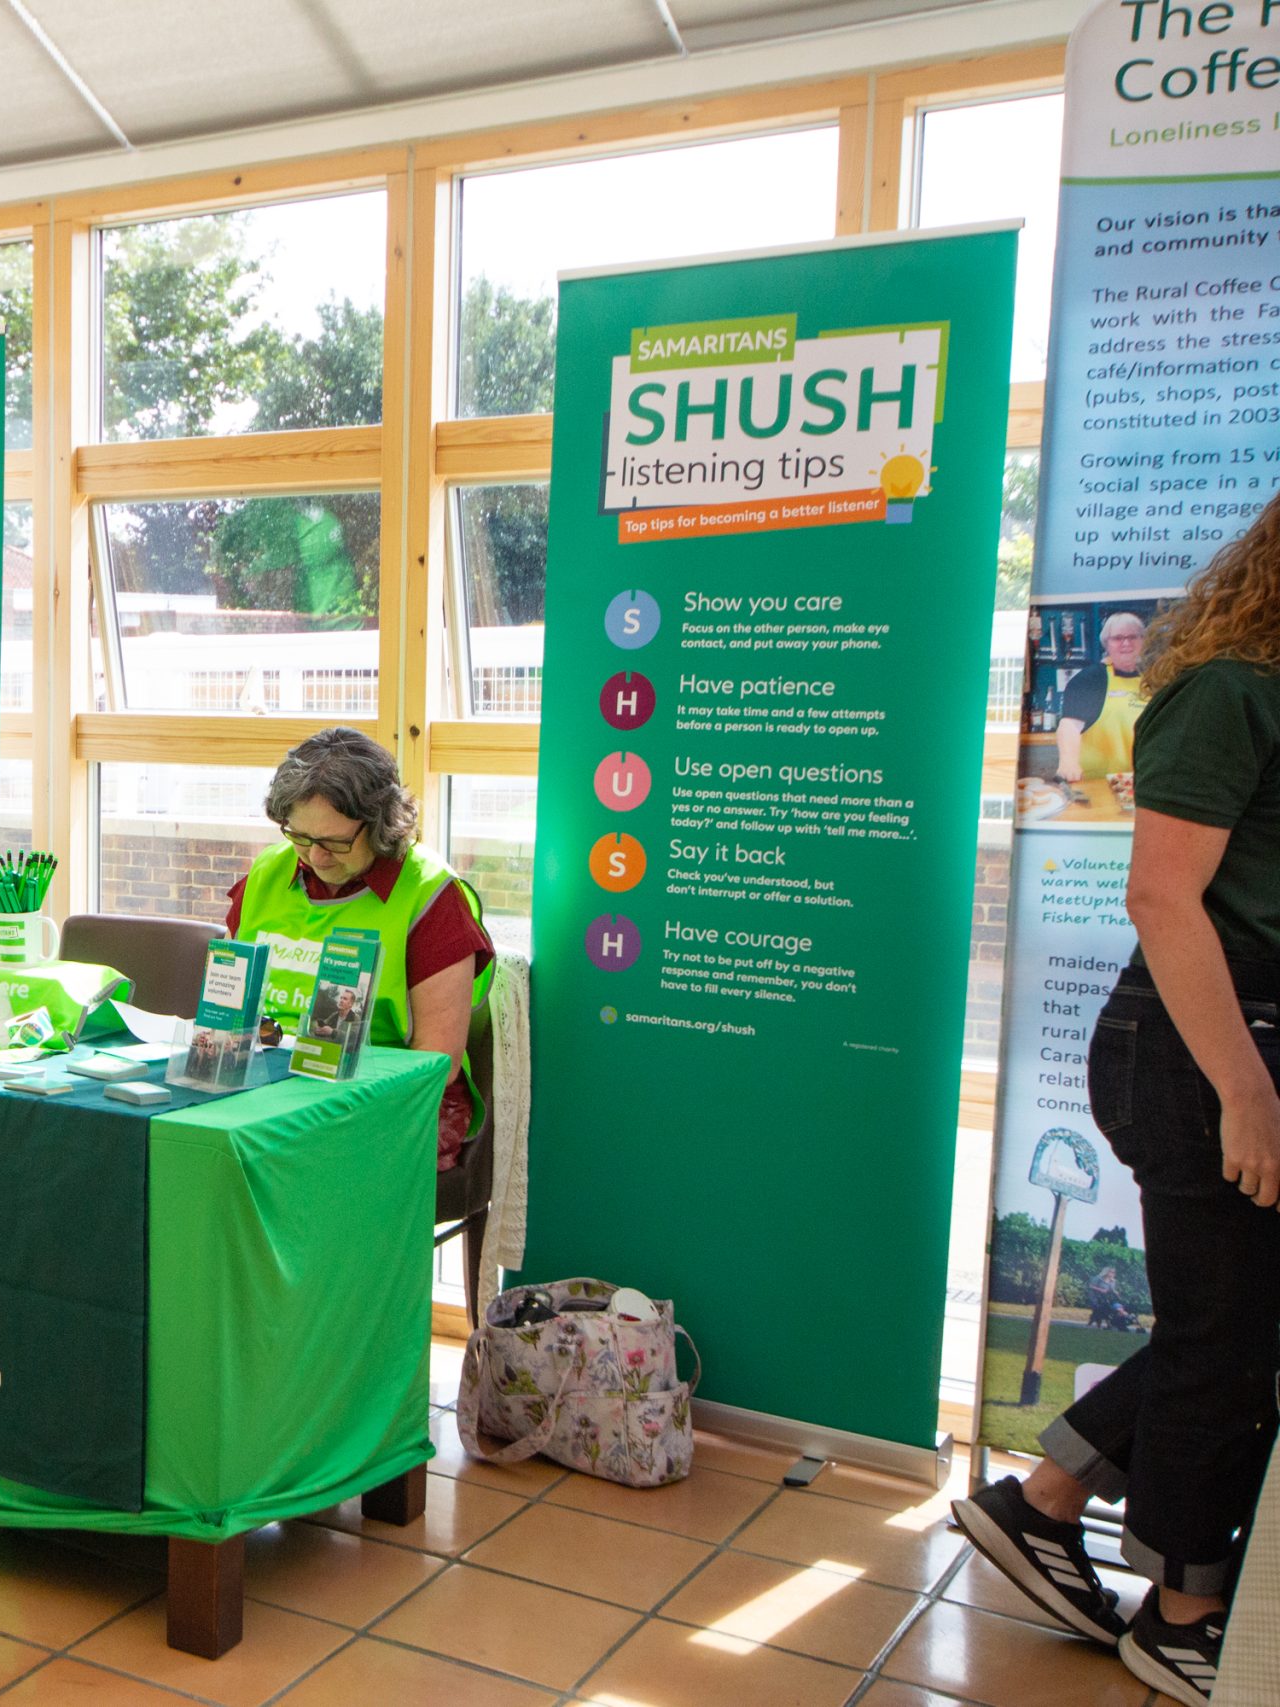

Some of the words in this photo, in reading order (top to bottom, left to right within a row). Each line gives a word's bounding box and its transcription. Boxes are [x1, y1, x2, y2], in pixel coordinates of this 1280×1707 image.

[1120, 0, 1234, 42] The
[1110, 119, 1261, 147] Loneliness
[1097, 217, 1135, 232] Our
[1144, 211, 1209, 228] vision
[1218, 207, 1237, 222] is
[1094, 240, 1133, 256] and
[1142, 230, 1269, 253] community
[1093, 287, 1128, 303] The
[1136, 281, 1188, 300] Rural
[1195, 278, 1262, 296] Coffee
[1090, 311, 1139, 329] work
[1152, 307, 1197, 325] with
[1210, 305, 1244, 322] the
[638, 327, 788, 361] SAMARITANS
[1088, 337, 1166, 354] address
[1177, 334, 1210, 349] the
[1086, 357, 1258, 380] café/information
[624, 364, 917, 446] SHUSH
[1085, 388, 1145, 408] (pubs,
[1157, 386, 1221, 403] shops,
[1083, 410, 1196, 430] constituted
[1203, 410, 1221, 425] in
[621, 452, 765, 490] listening
[778, 448, 845, 487] tips
[1080, 452, 1164, 469] Growing
[1172, 449, 1220, 465] from
[1230, 448, 1255, 463] 15
[1150, 478, 1208, 494] space
[1218, 475, 1237, 489] in
[1248, 477, 1259, 488] a
[624, 520, 648, 534] Top
[650, 518, 674, 532] tips
[676, 515, 696, 527] for
[699, 510, 766, 526] becoming
[769, 509, 779, 519] a
[781, 504, 824, 518] better
[828, 499, 880, 513] listener
[1076, 503, 1138, 520] village
[1145, 501, 1183, 517] and
[1074, 531, 1099, 545] up
[1111, 526, 1170, 542] whilst
[1182, 525, 1223, 541] also
[1073, 552, 1133, 570] happy
[1139, 551, 1197, 570] living.
[684, 591, 743, 612] Show
[748, 596, 787, 616] you
[793, 596, 842, 611] care
[623, 608, 641, 634] S
[682, 622, 714, 633] Focus
[715, 624, 730, 633] on
[732, 622, 752, 634] the
[753, 622, 784, 634] other
[786, 624, 829, 635] person,
[832, 622, 866, 633] make
[867, 624, 889, 636] eye
[680, 638, 726, 649] contact,
[728, 638, 752, 648] and
[753, 638, 773, 650] put
[775, 640, 809, 650] away
[811, 640, 839, 651] your
[840, 638, 881, 651] phone.
[679, 674, 734, 694] Have
[740, 675, 835, 699] patience
[616, 691, 638, 716] H
[677, 704, 686, 714] It
[687, 706, 713, 717] may
[715, 706, 741, 716] take
[743, 706, 769, 717] time
[770, 707, 794, 718] and
[796, 709, 805, 718] a
[807, 707, 829, 718] few
[831, 709, 885, 721] attempts
[674, 756, 713, 777] Use
[718, 763, 772, 783] open
[778, 763, 883, 785] questions
[612, 771, 634, 797] U
[669, 838, 709, 864] Say
[715, 842, 728, 862] it
[735, 843, 785, 865] back
[608, 852, 627, 877] S
[601, 932, 624, 957] H
[664, 920, 719, 943] Have
[724, 930, 812, 956] courage
[1048, 956, 1119, 973] maiden
[1043, 978, 1111, 997] cuppas
[1043, 1000, 1081, 1017] that
[625, 1013, 755, 1035] samaritans.org/shush
[1041, 1025, 1087, 1042] rural
